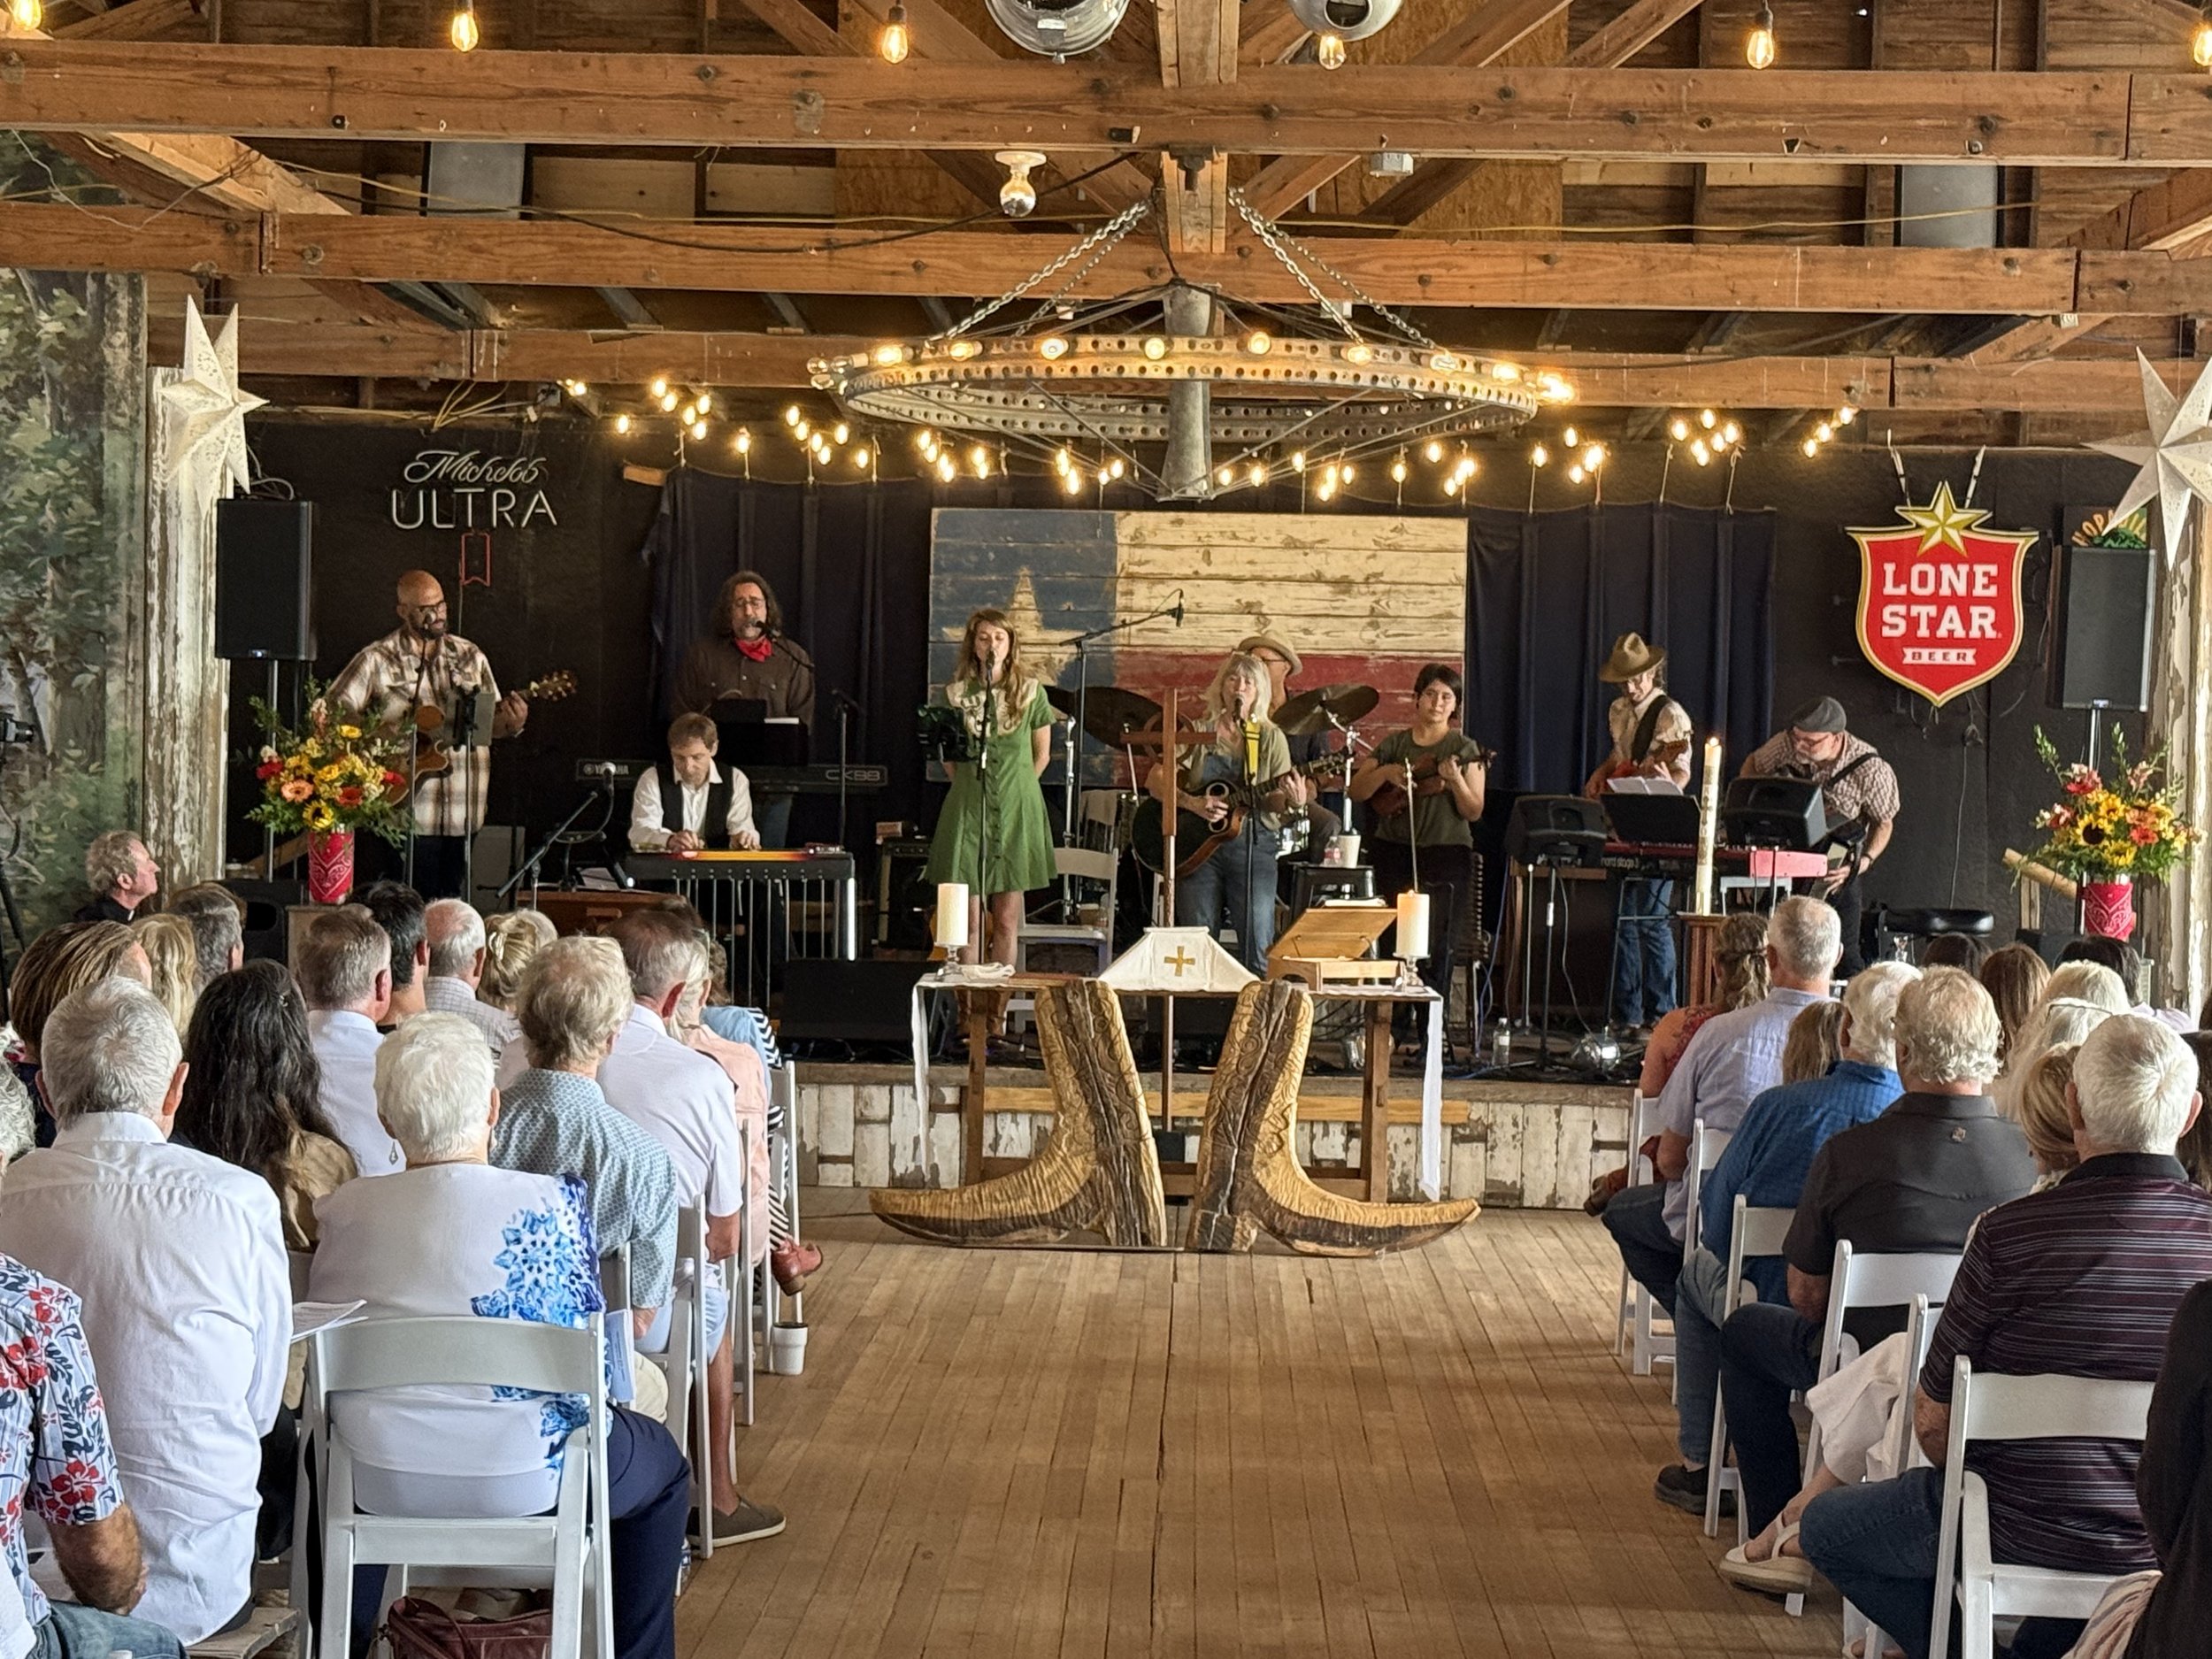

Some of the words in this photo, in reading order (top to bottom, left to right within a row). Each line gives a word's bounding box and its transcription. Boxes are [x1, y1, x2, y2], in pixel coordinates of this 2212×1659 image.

[404, 449, 547, 483] Michelob
[392, 488, 557, 529] ULTRA
[1883, 562, 1999, 597] LONE
[1881, 603, 1998, 639] STAR
[1911, 651, 1967, 663] BEER
